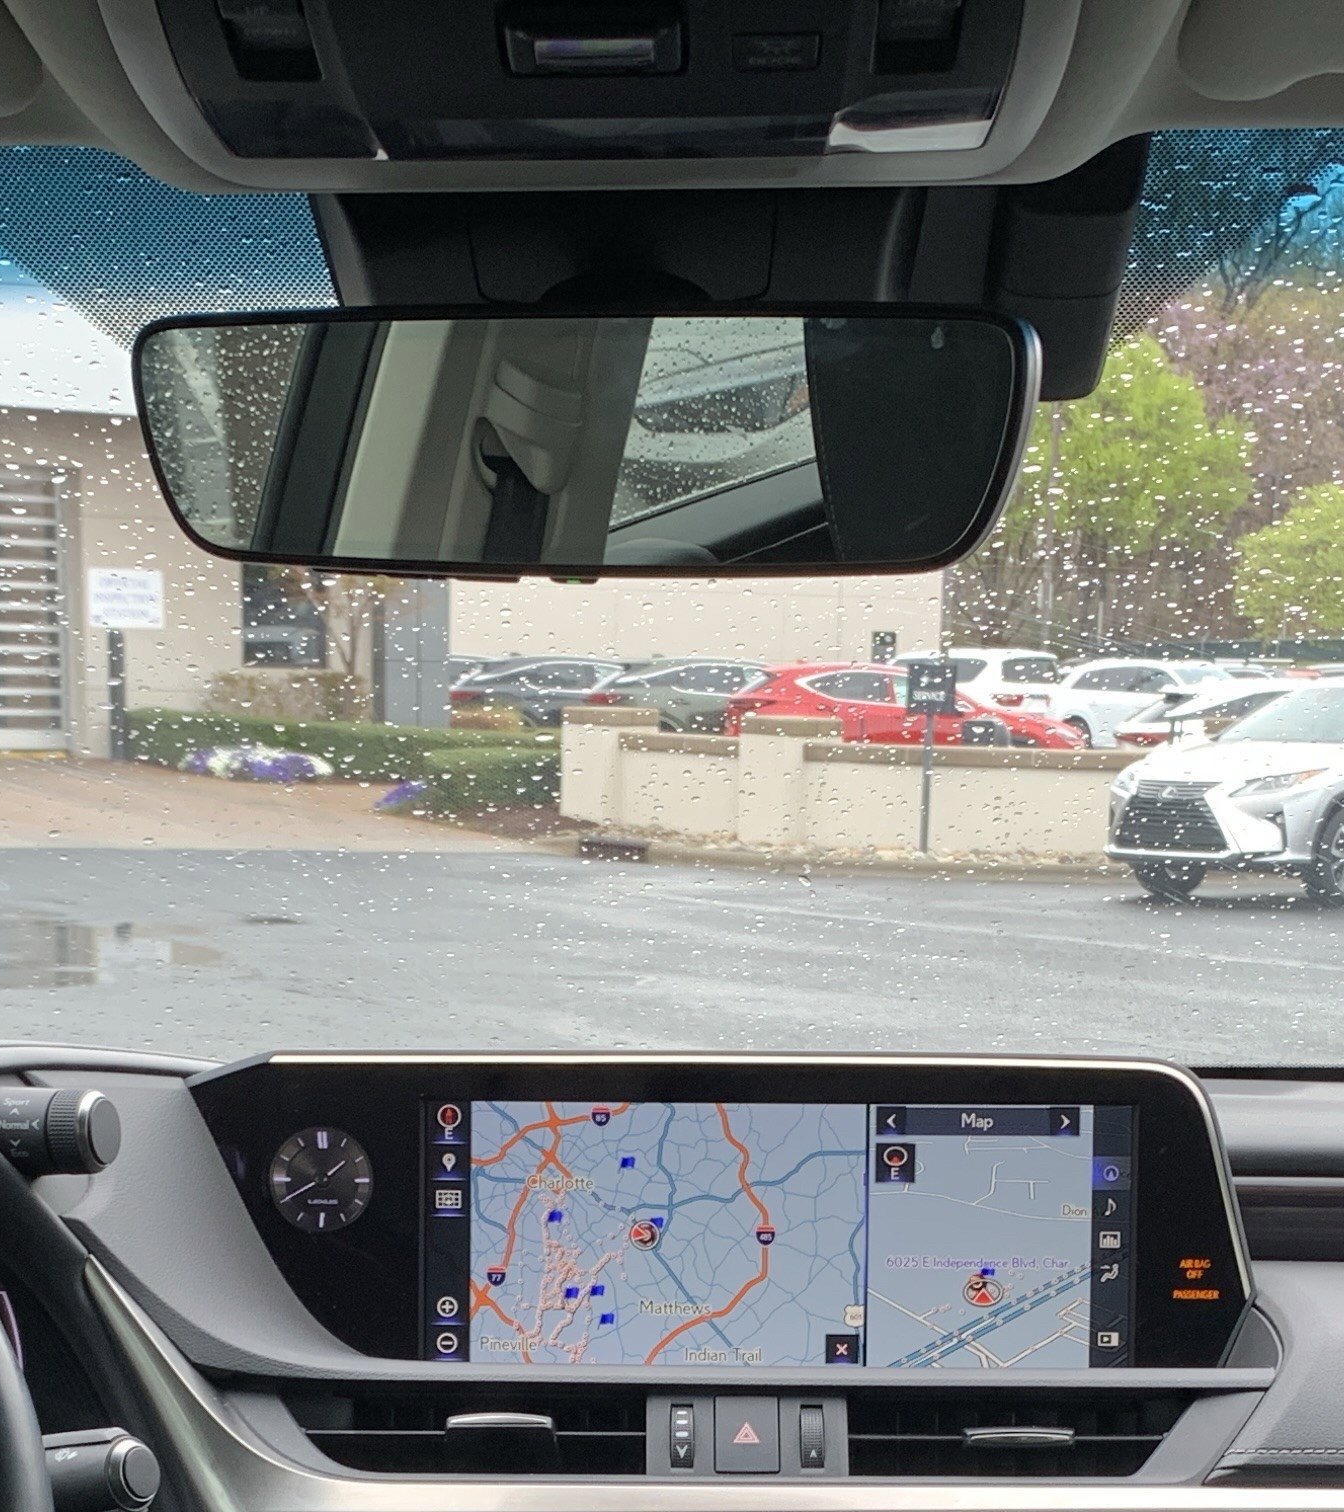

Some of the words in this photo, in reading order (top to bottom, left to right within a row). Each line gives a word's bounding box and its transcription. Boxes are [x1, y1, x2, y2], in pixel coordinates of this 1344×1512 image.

[3, 1097, 30, 1109] Sport
[960, 1113, 994, 1131] Map
[444, 1128, 454, 1140] E
[890, 1168, 900, 1180] E
[526, 1174, 595, 1191] Charlotte
[885, 1256, 919, 1269] 6025
[922, 1256, 930, 1269] E
[933, 1256, 1007, 1270] Independence
[1011, 1256, 1039, 1270] Blvd,
[1172, 1289, 1220, 1300] PASSENGER
[638, 1301, 712, 1316] Matthews
[479, 1336, 538, 1353] Pineville
[683, 1347, 729, 1362] Indian
[733, 1347, 762, 1362] Trail
